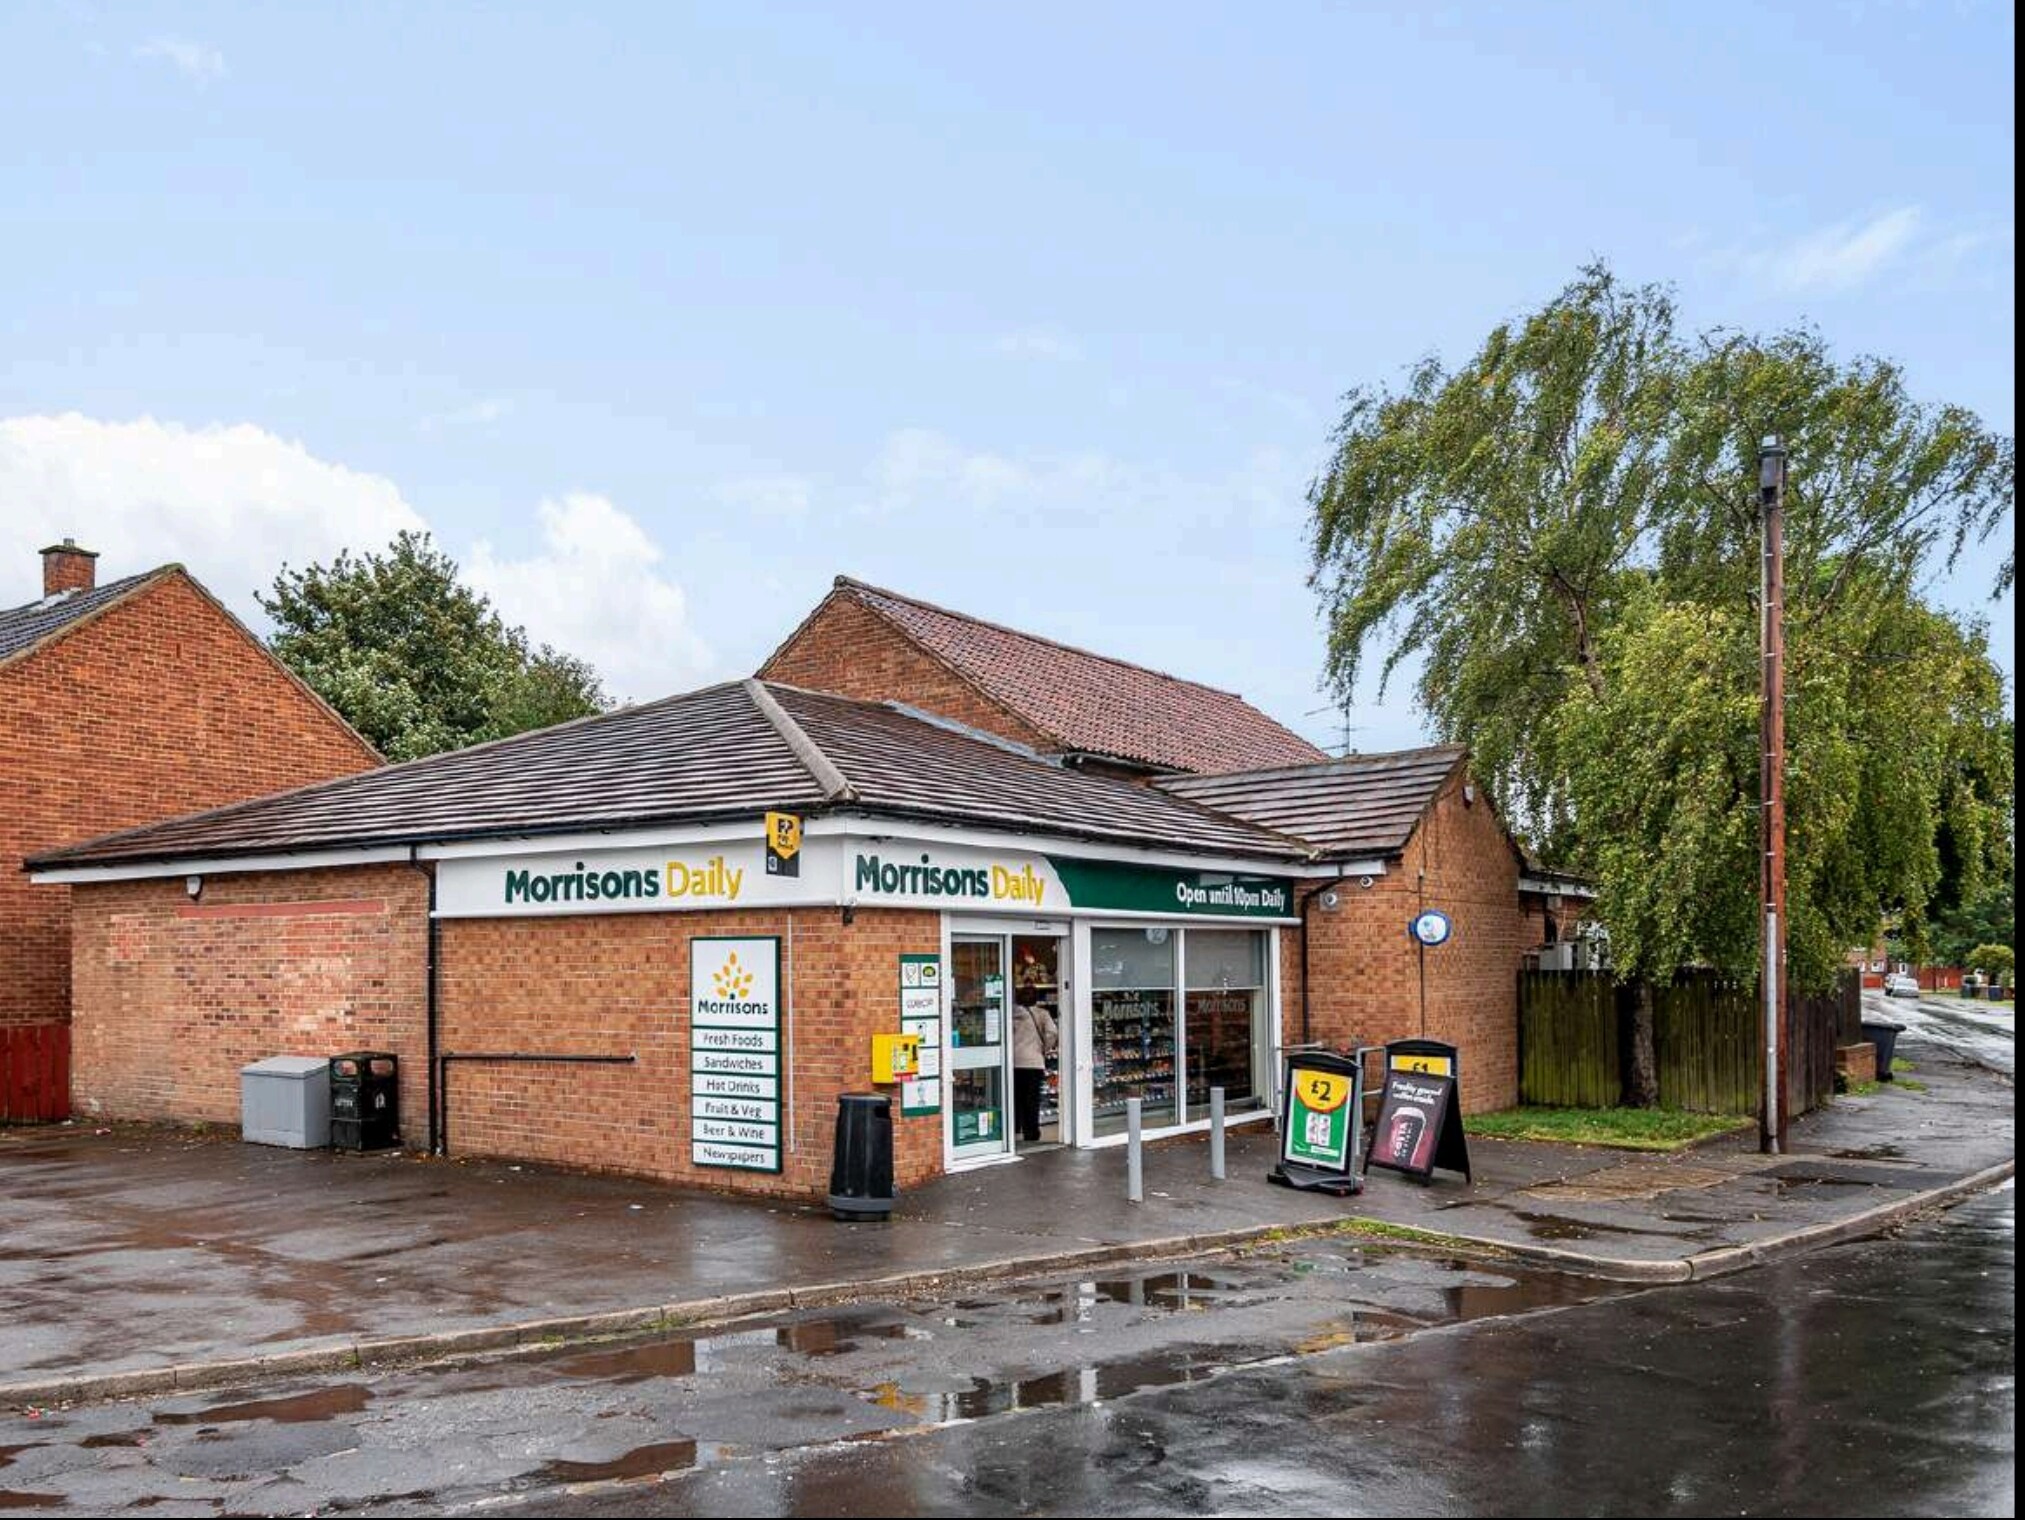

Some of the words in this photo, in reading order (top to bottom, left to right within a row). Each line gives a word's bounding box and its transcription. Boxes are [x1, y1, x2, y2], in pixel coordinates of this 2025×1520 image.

[505, 861, 660, 903] Morrisons
[666, 856, 743, 900] Daily
[856, 853, 990, 898] Morrisons
[992, 864, 1045, 905] Daily
[1176, 882, 1207, 909] Open
[1209, 884, 1233, 904] until
[1234, 886, 1260, 911] 10pm
[1261, 887, 1286, 912] Daily
[698, 993, 769, 1015] Morrisons
[704, 1033, 730, 1046] Fresh
[732, 1034, 764, 1048] Foods
[704, 1056, 764, 1071] Sandwiches
[706, 1079, 726, 1092] Hot
[728, 1080, 761, 1094] Drinks
[1310, 1080, 1331, 1102] £2
[705, 1101, 729, 1115] Fruit
[731, 1104, 739, 1116] &
[742, 1104, 762, 1119] Veg
[703, 1122, 726, 1136] Beer
[728, 1125, 735, 1137] &
[738, 1126, 765, 1140] Wine
[703, 1146, 765, 1164] Newspapers
